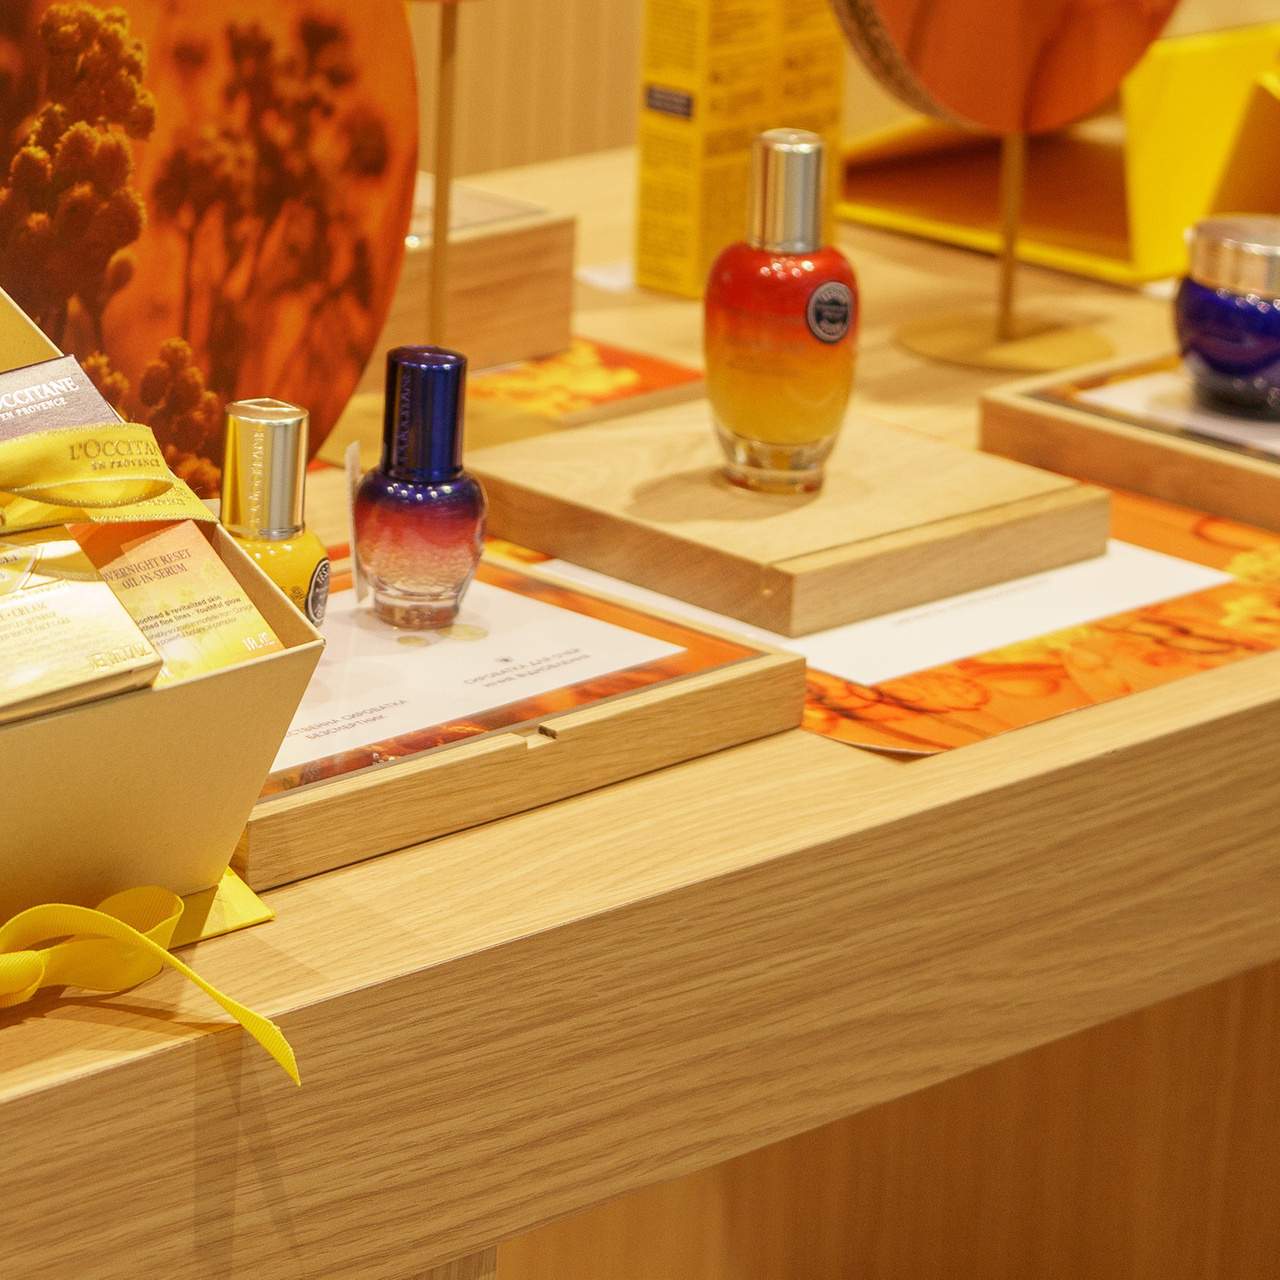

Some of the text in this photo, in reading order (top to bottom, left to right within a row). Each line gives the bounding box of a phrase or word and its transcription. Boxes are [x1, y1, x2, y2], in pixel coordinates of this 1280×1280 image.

[0, 397, 68, 422] EN PROVENCE
[161, 547, 193, 567] RESET
[121, 562, 188, 590] OIL-IN-SERUM
